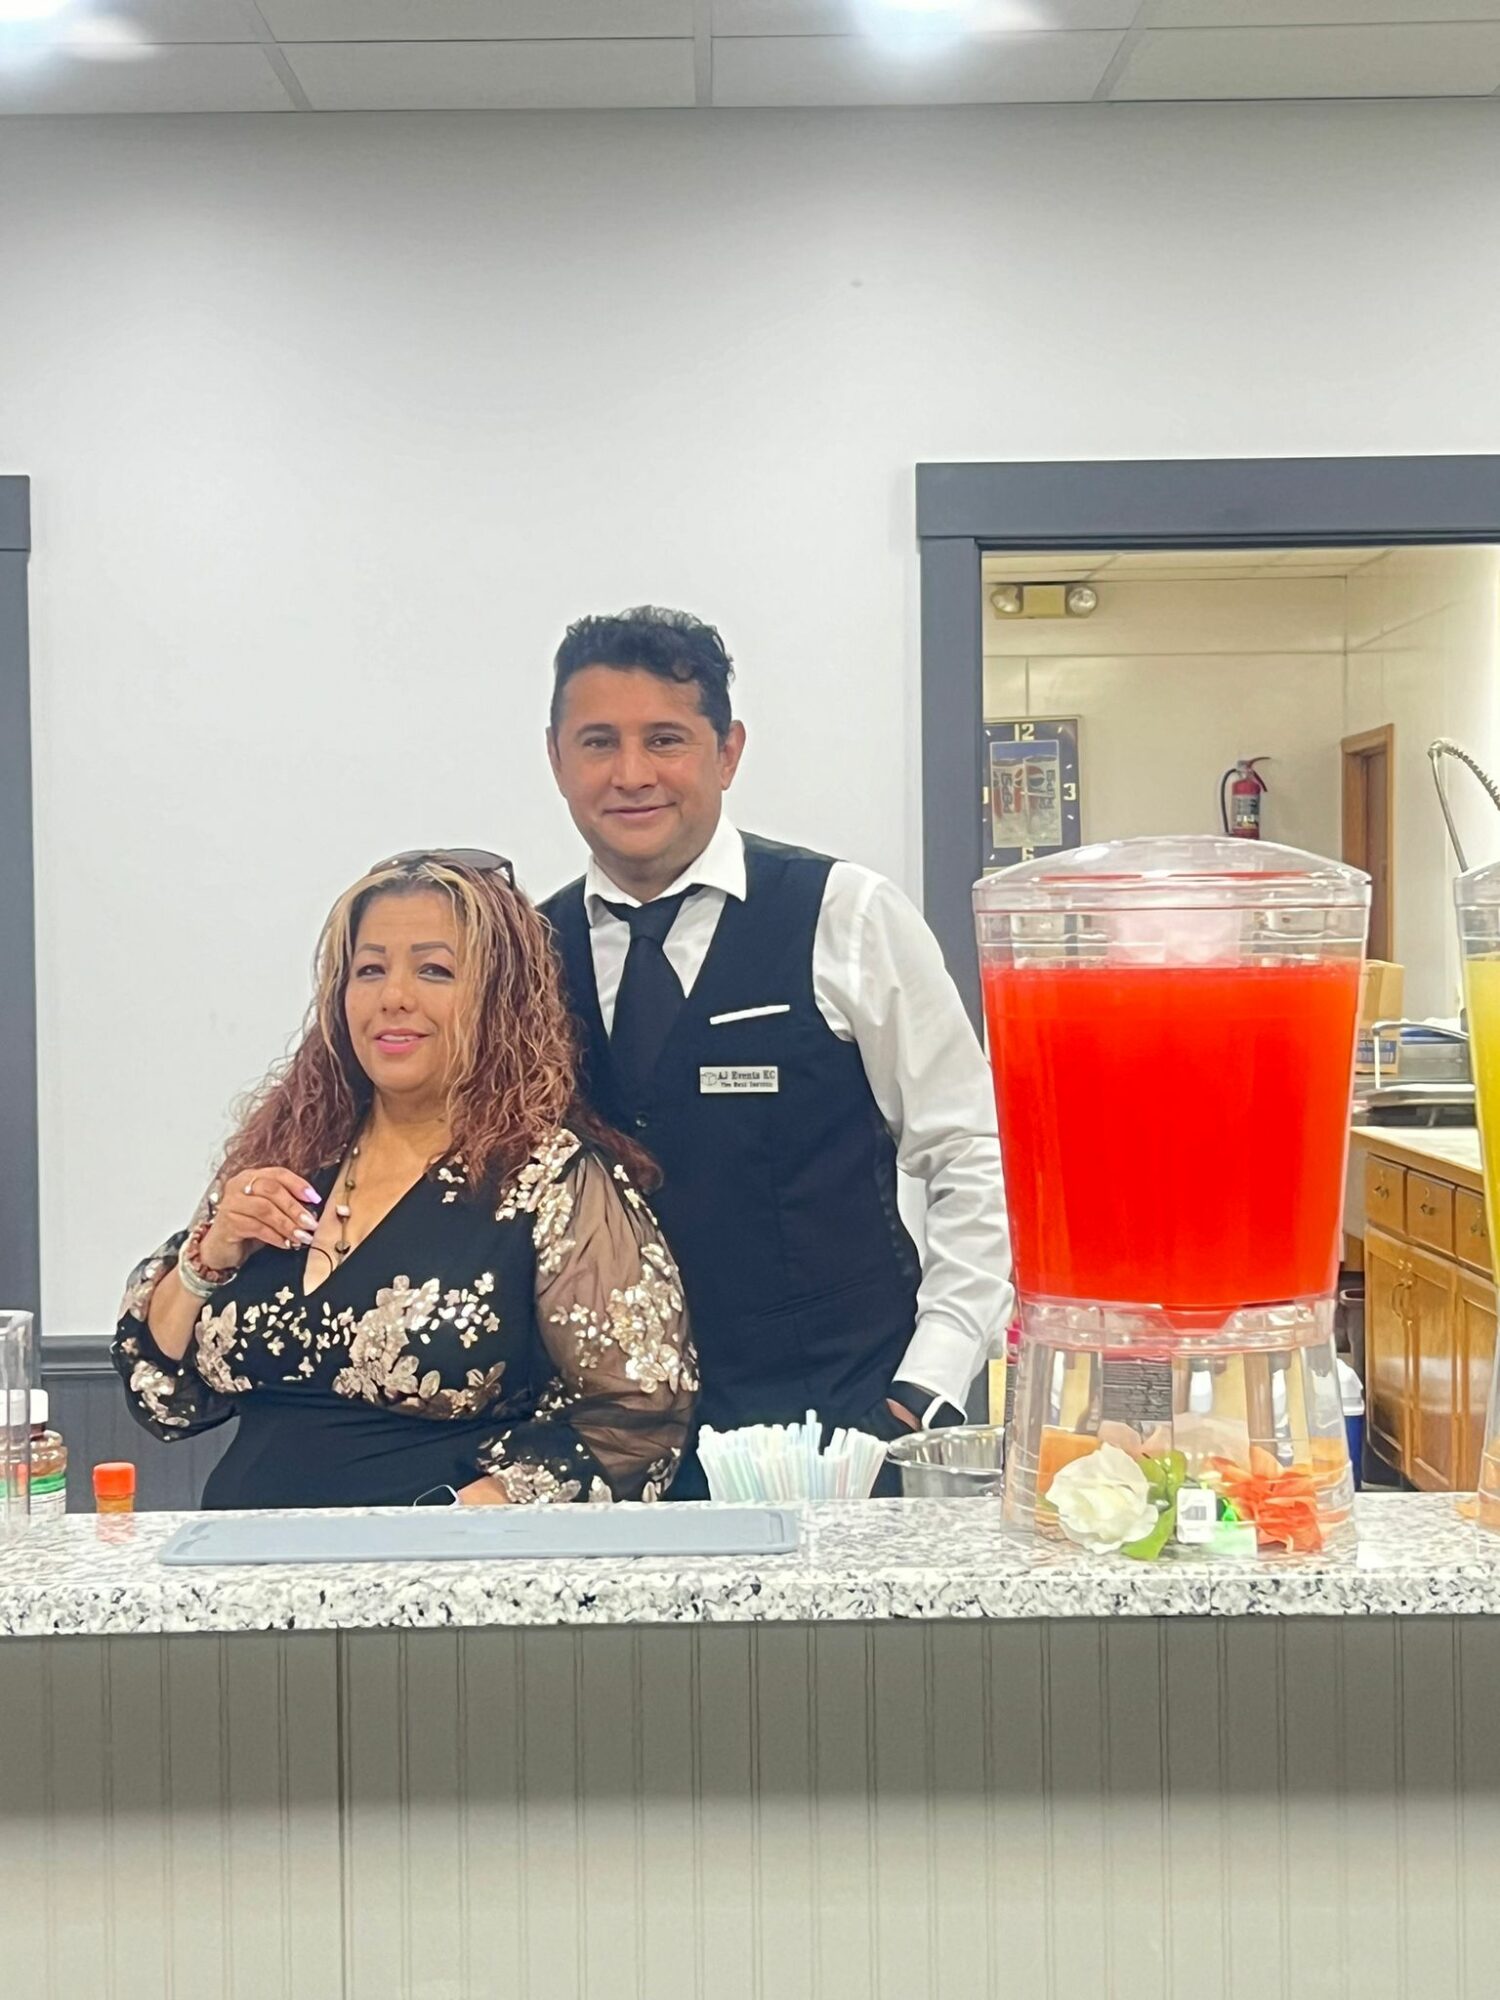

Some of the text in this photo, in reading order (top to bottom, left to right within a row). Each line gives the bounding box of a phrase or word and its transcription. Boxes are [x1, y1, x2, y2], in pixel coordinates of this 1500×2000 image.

[1014, 723, 1035, 741] 12
[1063, 783, 1076, 801] 3
[717, 1071, 729, 1080] AJ
[731, 1071, 760, 1080] Events
